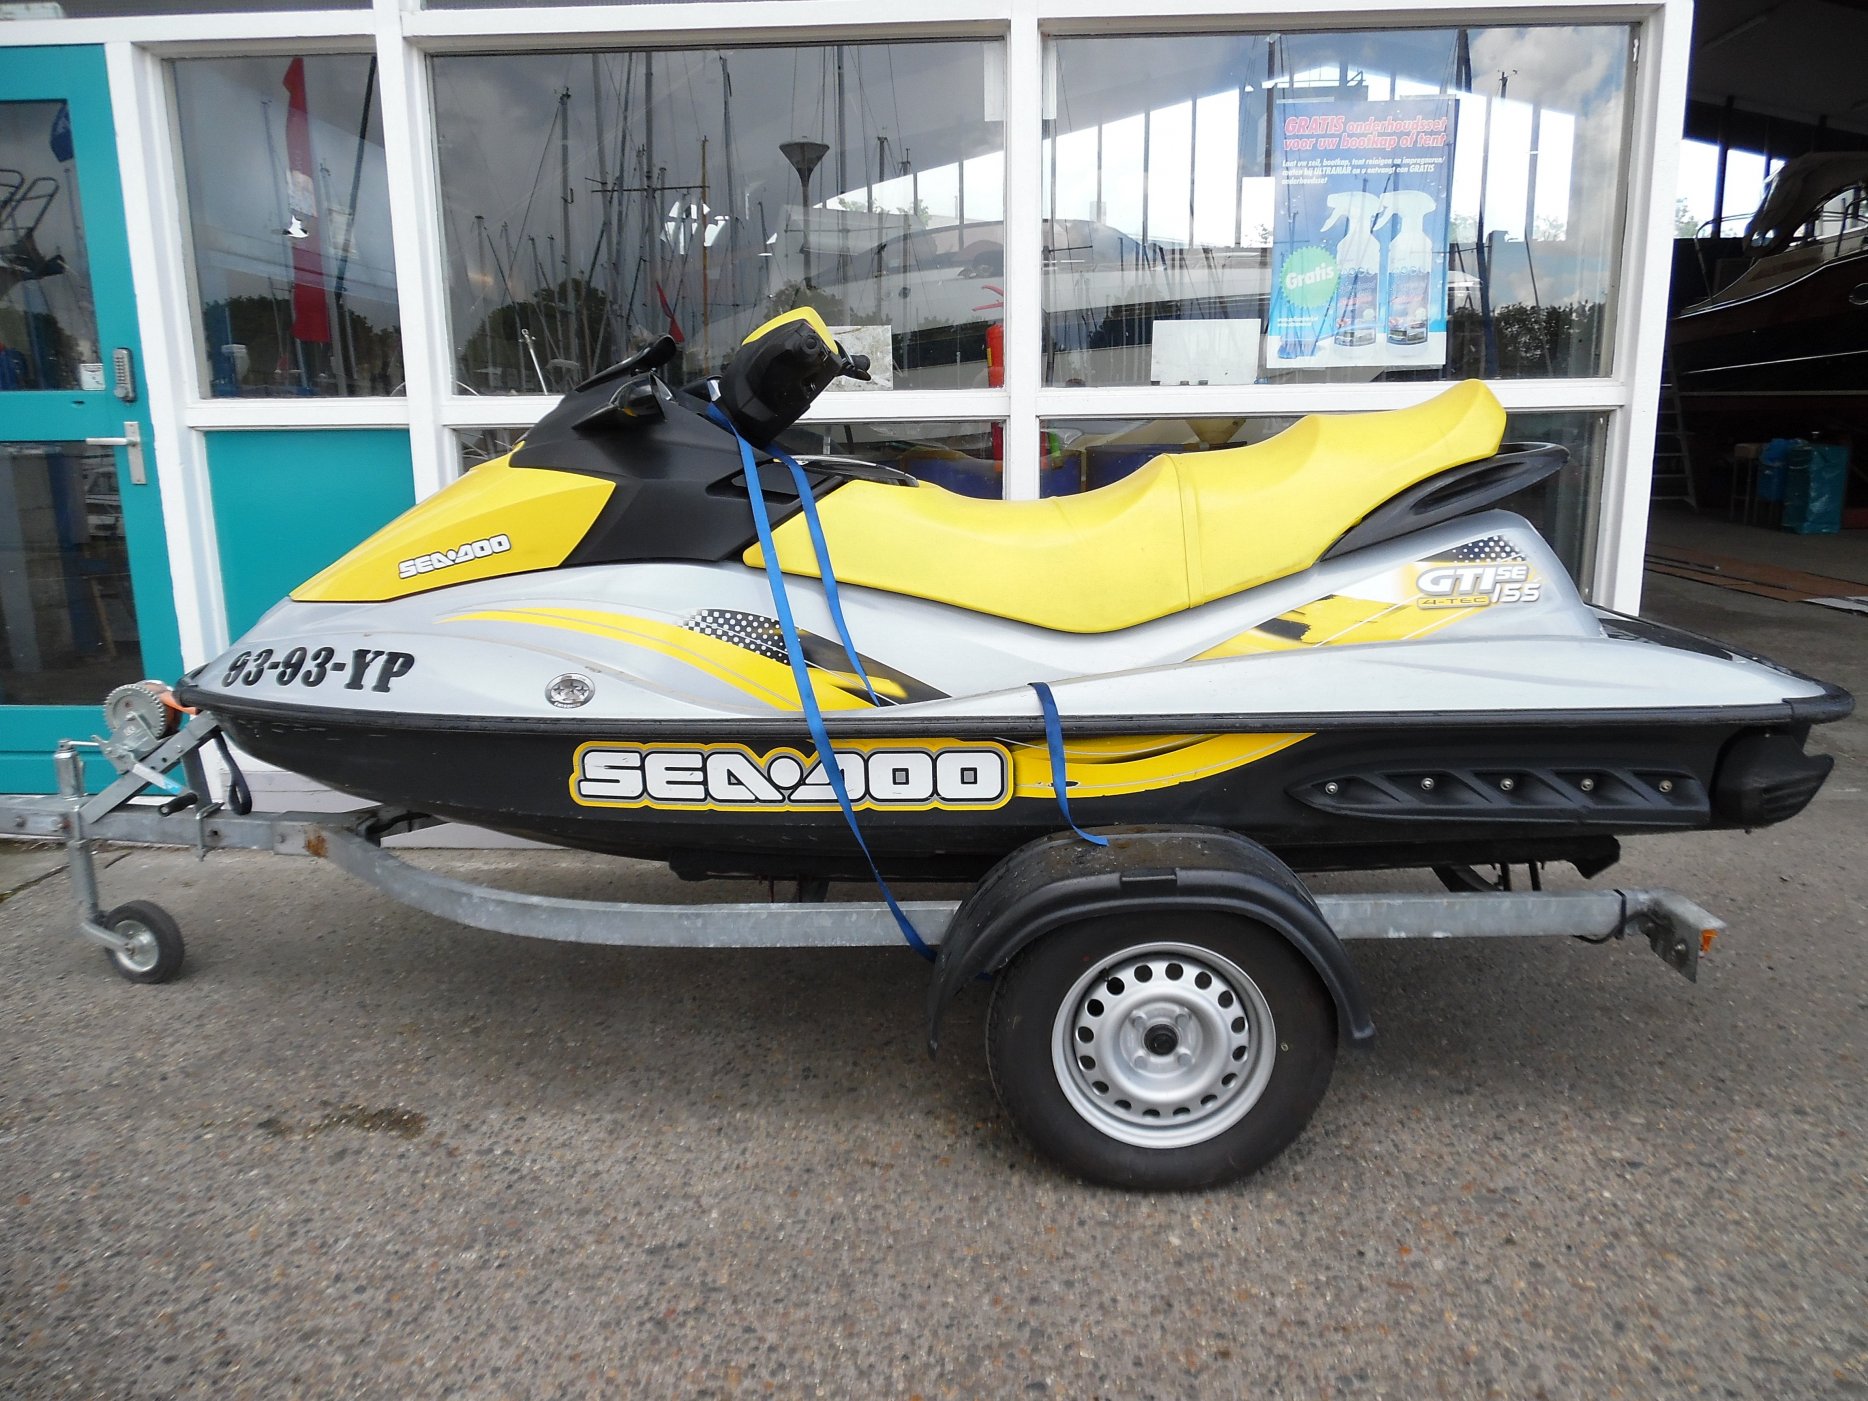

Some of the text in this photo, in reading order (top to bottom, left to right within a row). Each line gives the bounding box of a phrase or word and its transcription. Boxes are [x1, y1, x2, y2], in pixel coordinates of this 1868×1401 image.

[1285, 115, 1447, 135] GRATIS onderhoudsset
[1284, 132, 1446, 150] voor uw bootkap of tent
[1313, 166, 1352, 175] ULTRAMAR
[1409, 164, 1435, 173] GRATIS
[1286, 262, 1335, 290] Gratis
[1417, 565, 1528, 595] GTI SE
[1421, 583, 1541, 605] 4-TEC 155
[221, 646, 415, 693] 93-93-YP
